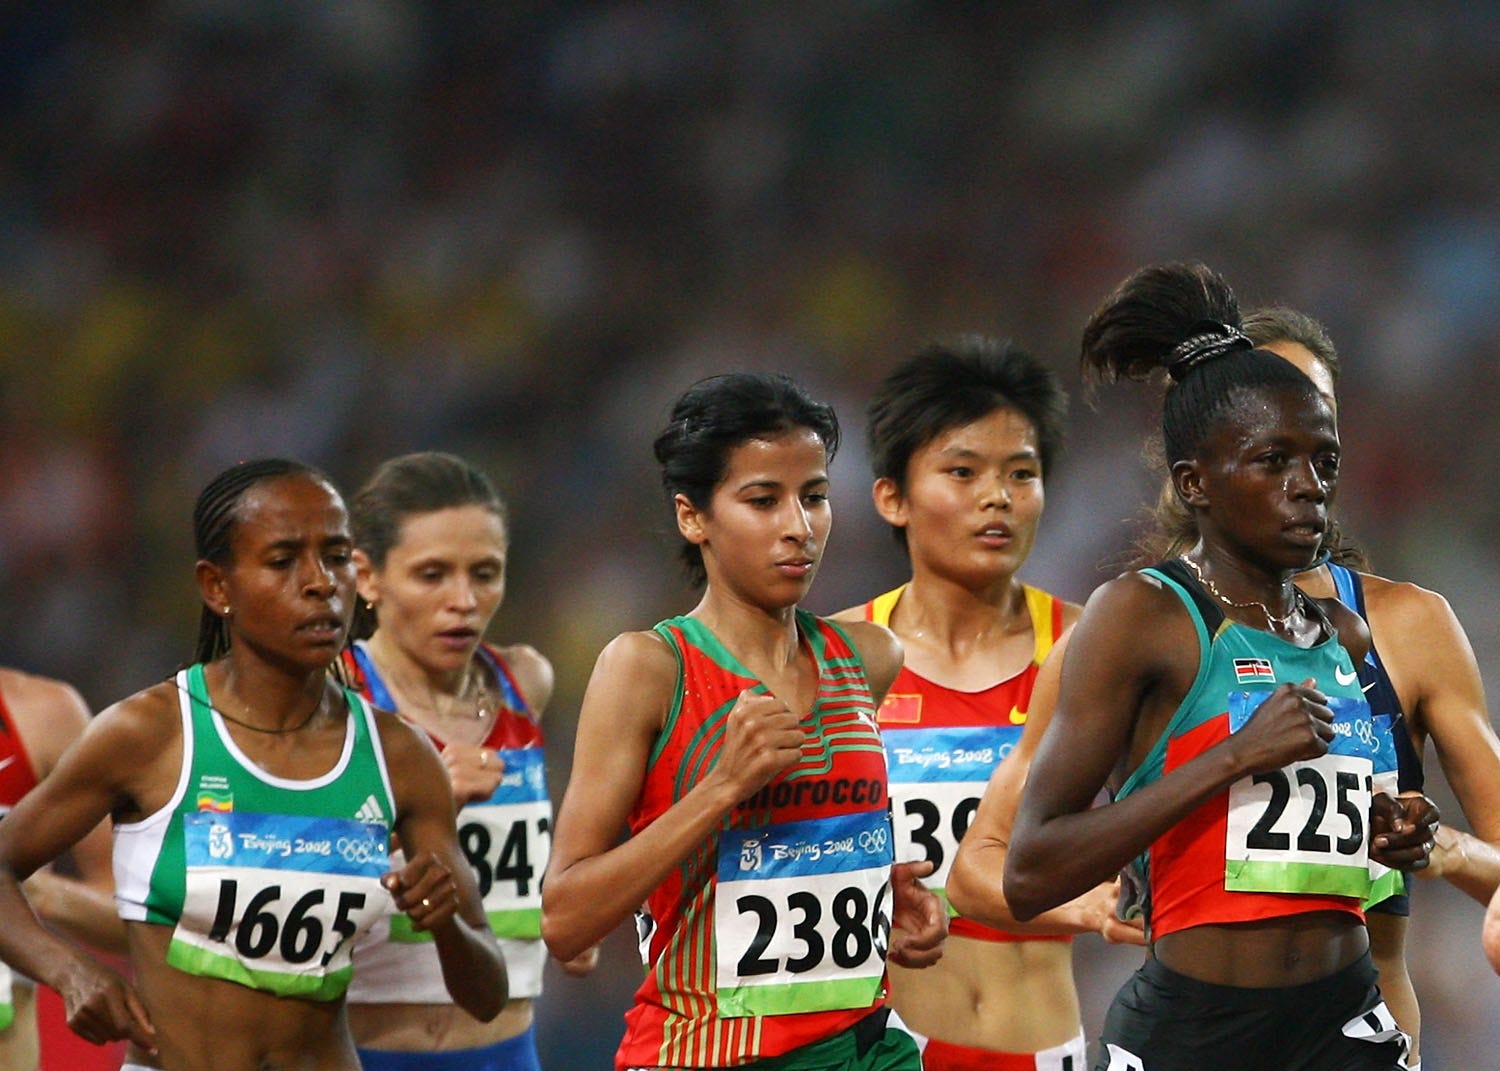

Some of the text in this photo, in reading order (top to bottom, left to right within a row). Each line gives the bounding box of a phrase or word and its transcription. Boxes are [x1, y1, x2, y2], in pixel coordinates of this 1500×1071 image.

[894, 747, 993, 768] Beijing 2008
[1246, 767, 1372, 856] 225
[238, 831, 332, 857] Beijing 2008
[768, 837, 854, 861] Beijing 2008
[208, 879, 367, 967] 1665
[736, 881, 890, 977] 2386
